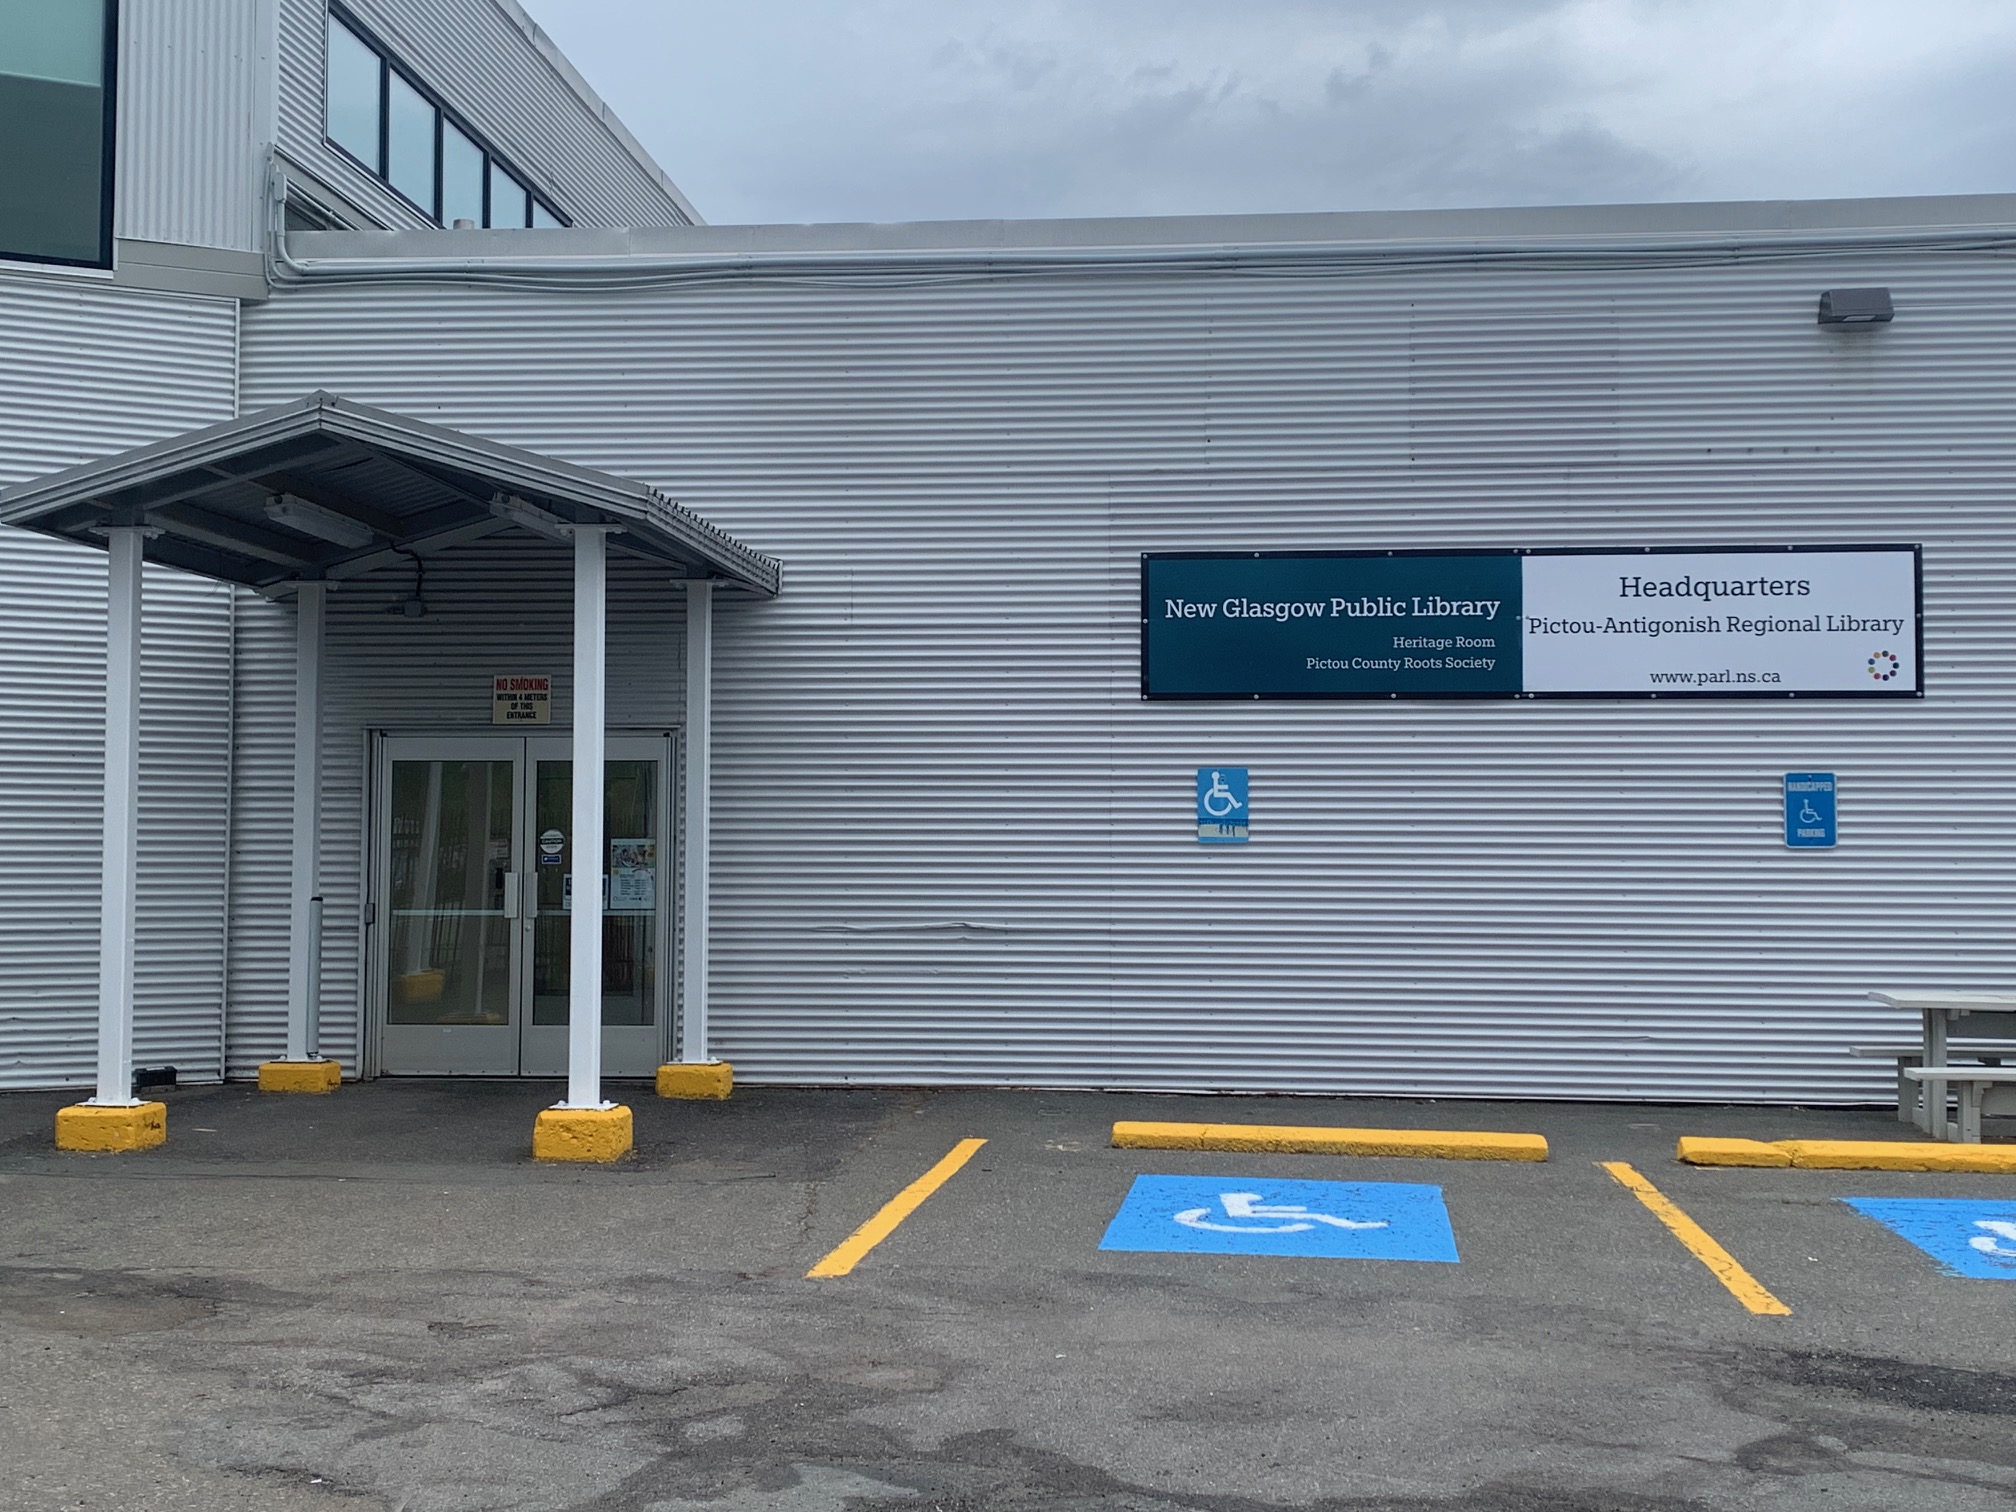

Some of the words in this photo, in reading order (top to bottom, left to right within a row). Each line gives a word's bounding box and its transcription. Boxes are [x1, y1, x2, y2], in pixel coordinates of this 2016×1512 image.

[1618, 575, 1811, 601] Headquarters
[1164, 598, 1217, 618] New
[1222, 597, 1325, 623] Glasgow
[1330, 596, 1406, 617] Public
[1412, 596, 1501, 621] Library
[1528, 615, 1721, 638] Pictou-Antigonish
[1726, 615, 1821, 637] Regional
[1826, 613, 1904, 636] Library
[1393, 635, 1453, 650] Heritage
[1455, 636, 1496, 649] Room
[1306, 656, 1349, 670] Pictou
[1352, 657, 1401, 671] County
[1404, 656, 1442, 669] Roots
[1445, 656, 1496, 671] Society
[496, 678, 508, 691] NO
[510, 677, 549, 691] SMOKING
[1649, 668, 1781, 687] www.parl.ns.ca
[496, 693, 518, 701] WITHIN
[518, 693, 523, 701] 4
[524, 693, 548, 701] METERS
[510, 702, 518, 710] OF
[520, 702, 534, 710] THIS
[506, 711, 537, 719] ENTRANCE
